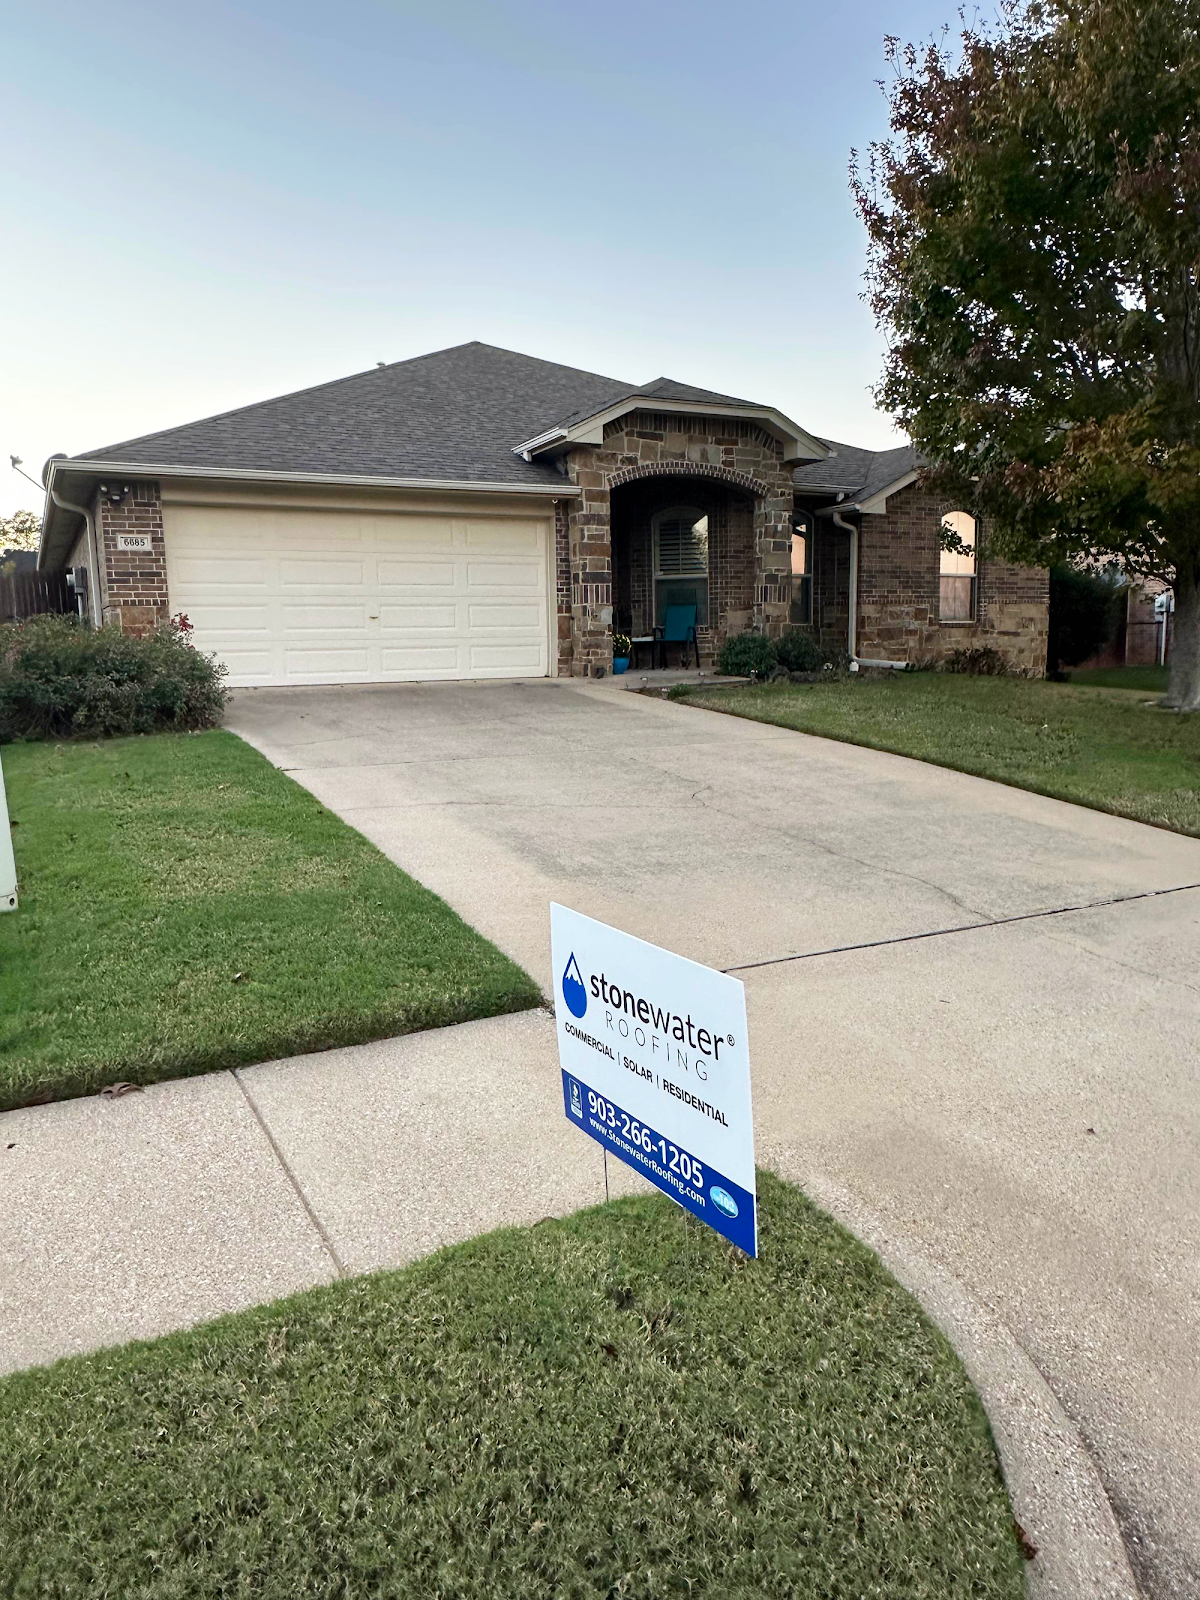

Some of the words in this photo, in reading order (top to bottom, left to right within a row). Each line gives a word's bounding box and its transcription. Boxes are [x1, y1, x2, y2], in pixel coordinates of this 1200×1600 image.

[565, 1022, 615, 1061] COMMERCIAL
[623, 1056, 653, 1083] SOLAR
[663, 1079, 729, 1127] RESIDENTIAL
[605, 1010, 708, 1081] ROOFING
[588, 1091, 704, 1188] 903-266-1205
[589, 1116, 706, 1207] www.StonewaterRoofing.com
